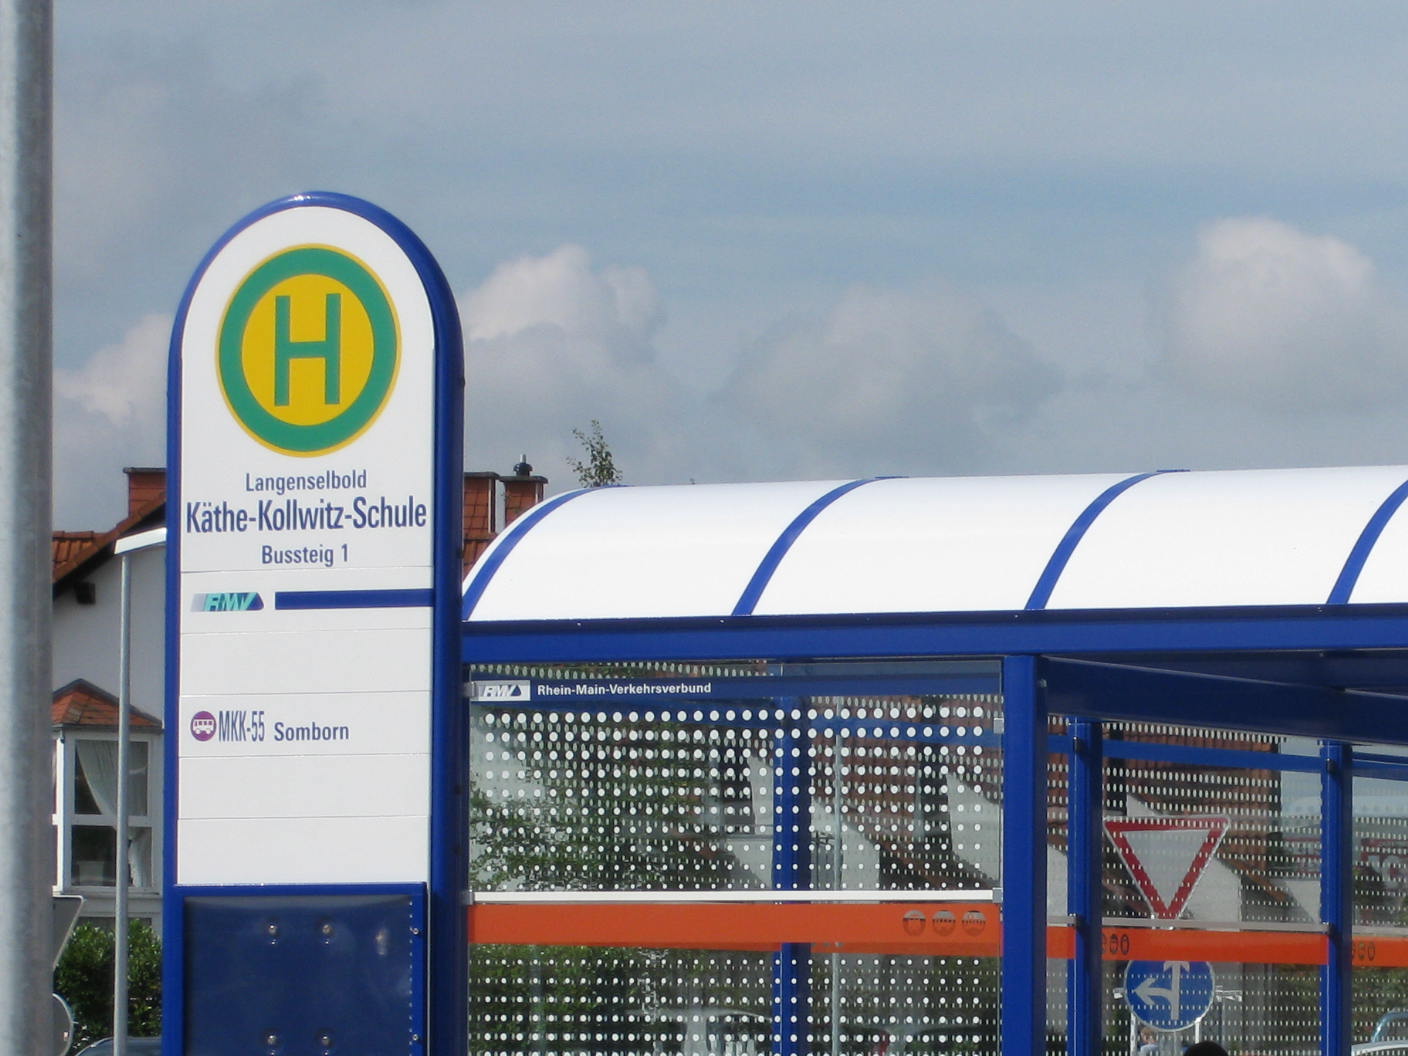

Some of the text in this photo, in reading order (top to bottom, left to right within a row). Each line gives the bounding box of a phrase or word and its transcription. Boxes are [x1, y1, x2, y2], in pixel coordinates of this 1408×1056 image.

[274, 292, 342, 407] H
[245, 469, 367, 496] Langenselbold
[186, 495, 428, 534] Käthe-Kollwitz-Schule
[261, 543, 349, 568] Bussteig 1
[536, 682, 712, 697] Rhein-Main-Verkehrsverbund
[218, 710, 350, 743] MKK-55 Somborn
